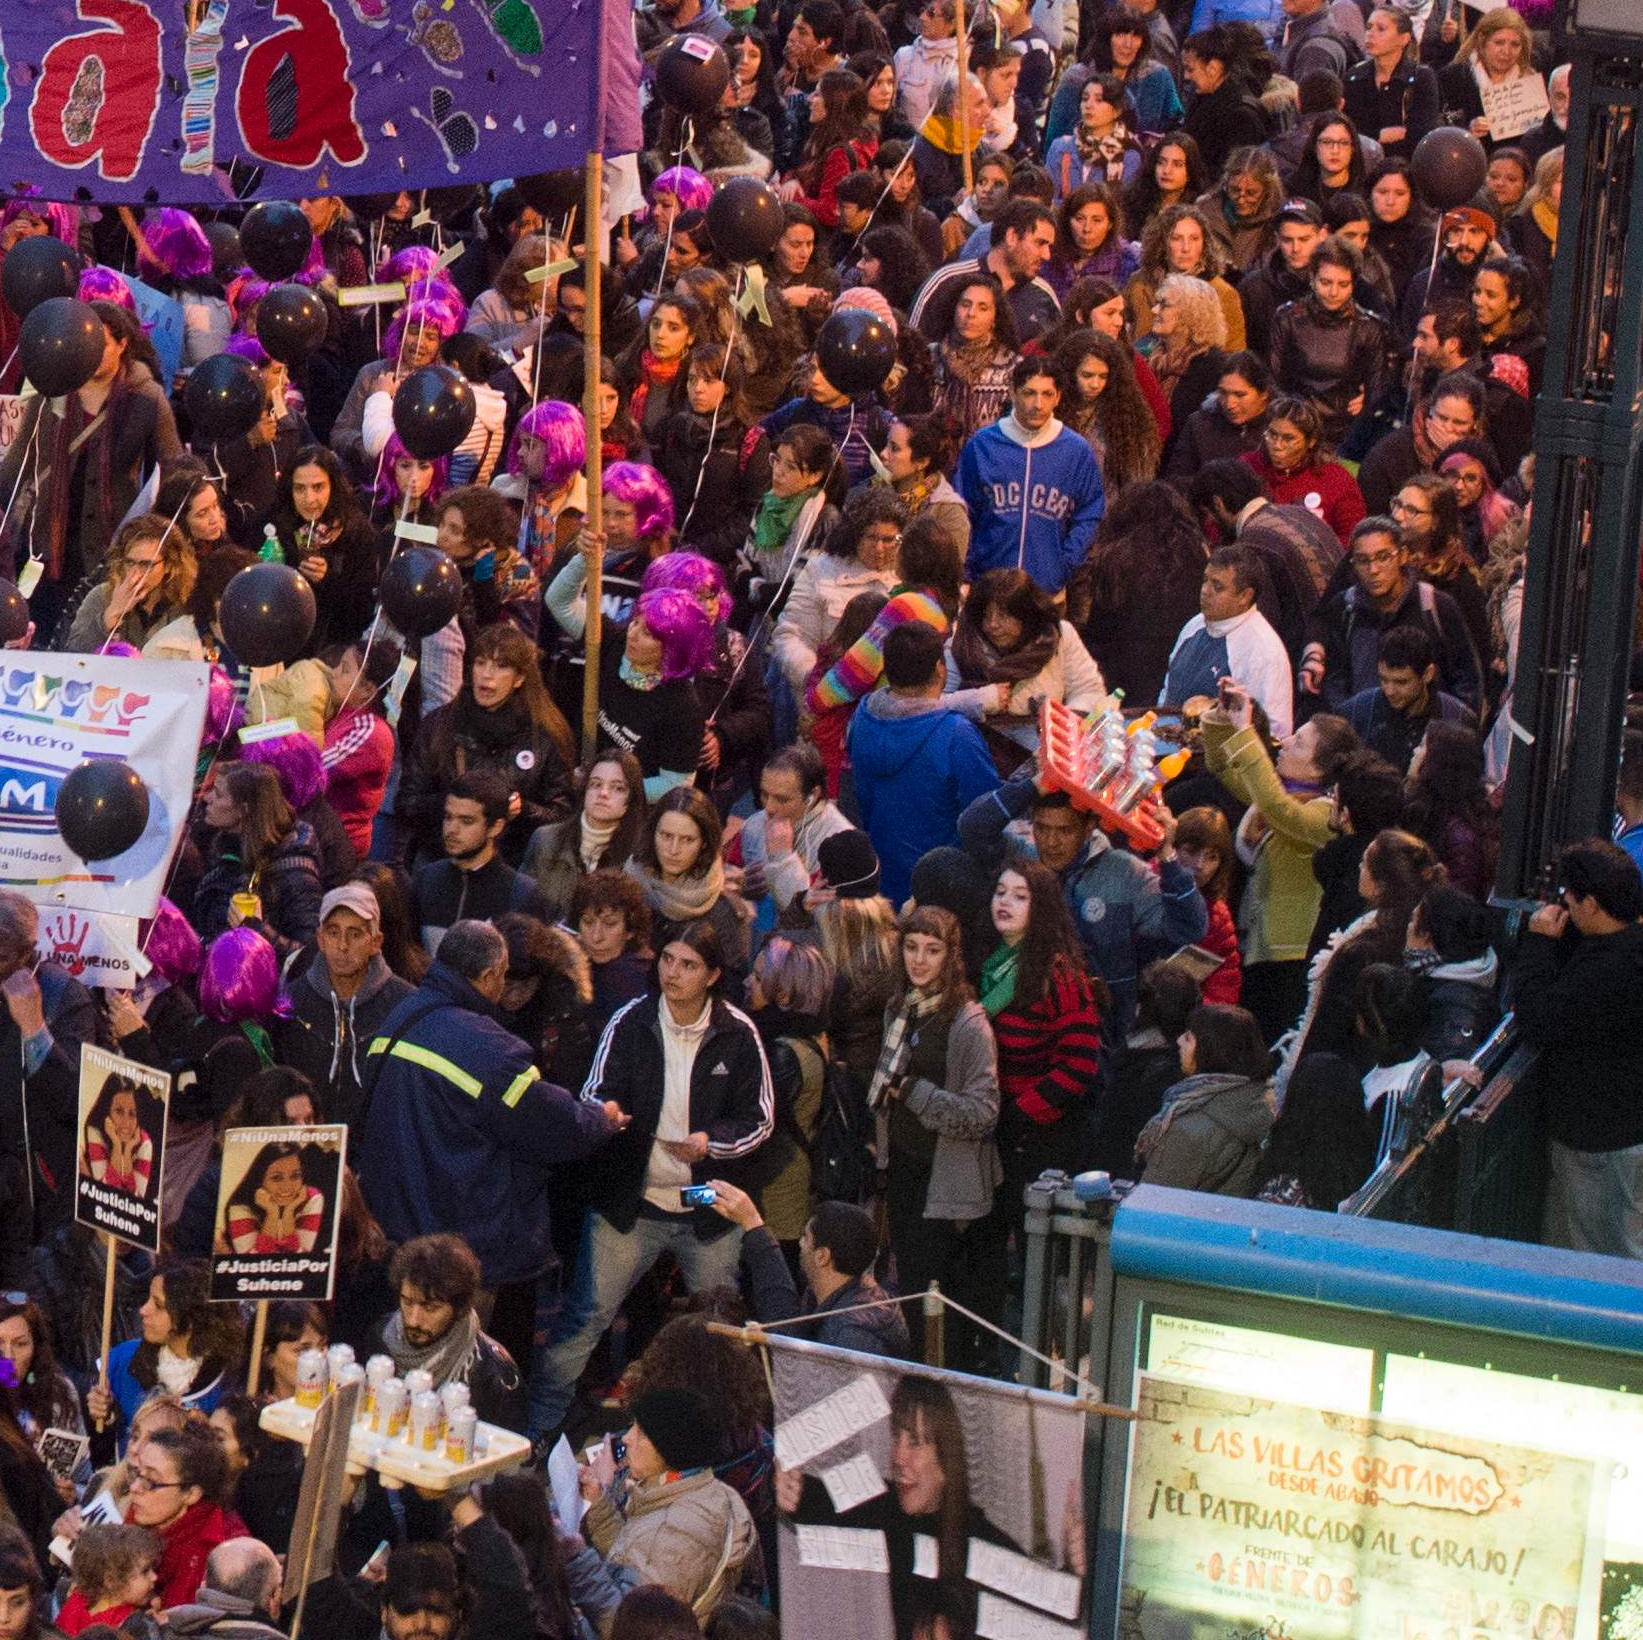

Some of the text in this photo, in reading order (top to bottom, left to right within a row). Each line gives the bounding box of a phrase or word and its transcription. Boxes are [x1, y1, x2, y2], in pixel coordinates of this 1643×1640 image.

[84, 1048, 166, 1091] #NiUnaMenos
[229, 1130, 339, 1144] #NiUnaMenos
[79, 1179, 158, 1224] #JusticiaPor
[94, 1205, 141, 1237] Suhene
[214, 1258, 329, 1275] #JusticiaPor
[236, 1276, 304, 1293] Suhene
[1193, 1426, 1492, 1508] LAS VILLAS GRITAMOS
[1267, 1469, 1380, 1508] DESDE ABAJO
[1197, 1491, 1367, 1549] PATRIARCADO
[1371, 1529, 1403, 1557] AL
[1243, 1542, 1317, 1568] FRENTE DE
